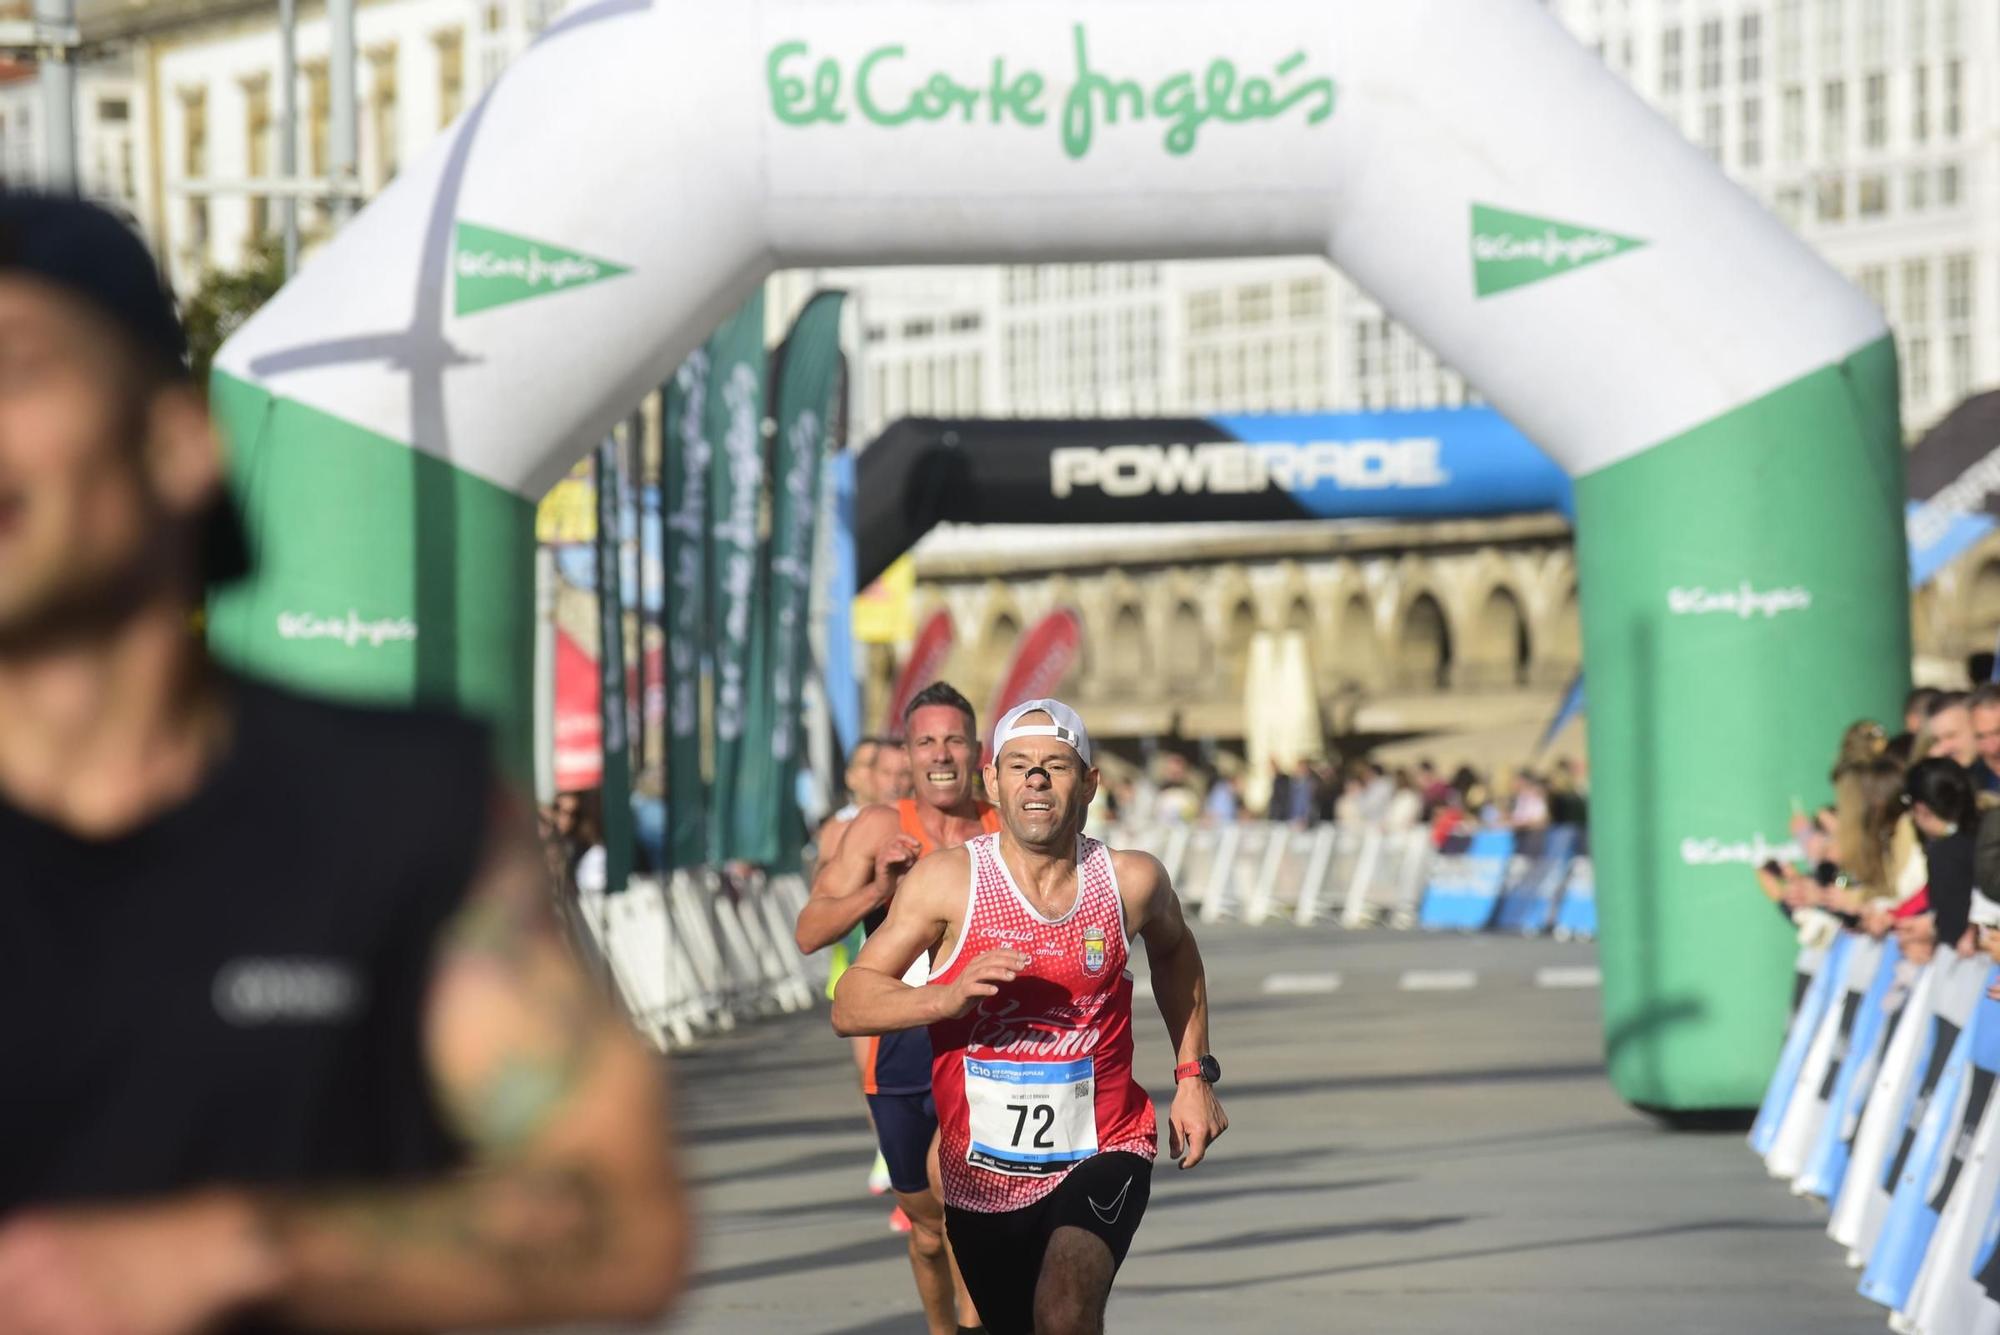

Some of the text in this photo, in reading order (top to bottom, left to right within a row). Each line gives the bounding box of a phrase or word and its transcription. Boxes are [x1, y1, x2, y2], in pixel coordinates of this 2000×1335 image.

[767, 22, 1336, 160] El Corte Inglés
[1050, 438, 1442, 498] POWERADE
[980, 928, 1034, 942] CONCELLO
[1036, 948, 1064, 957] amura
[1007, 1104, 1055, 1148] 72
